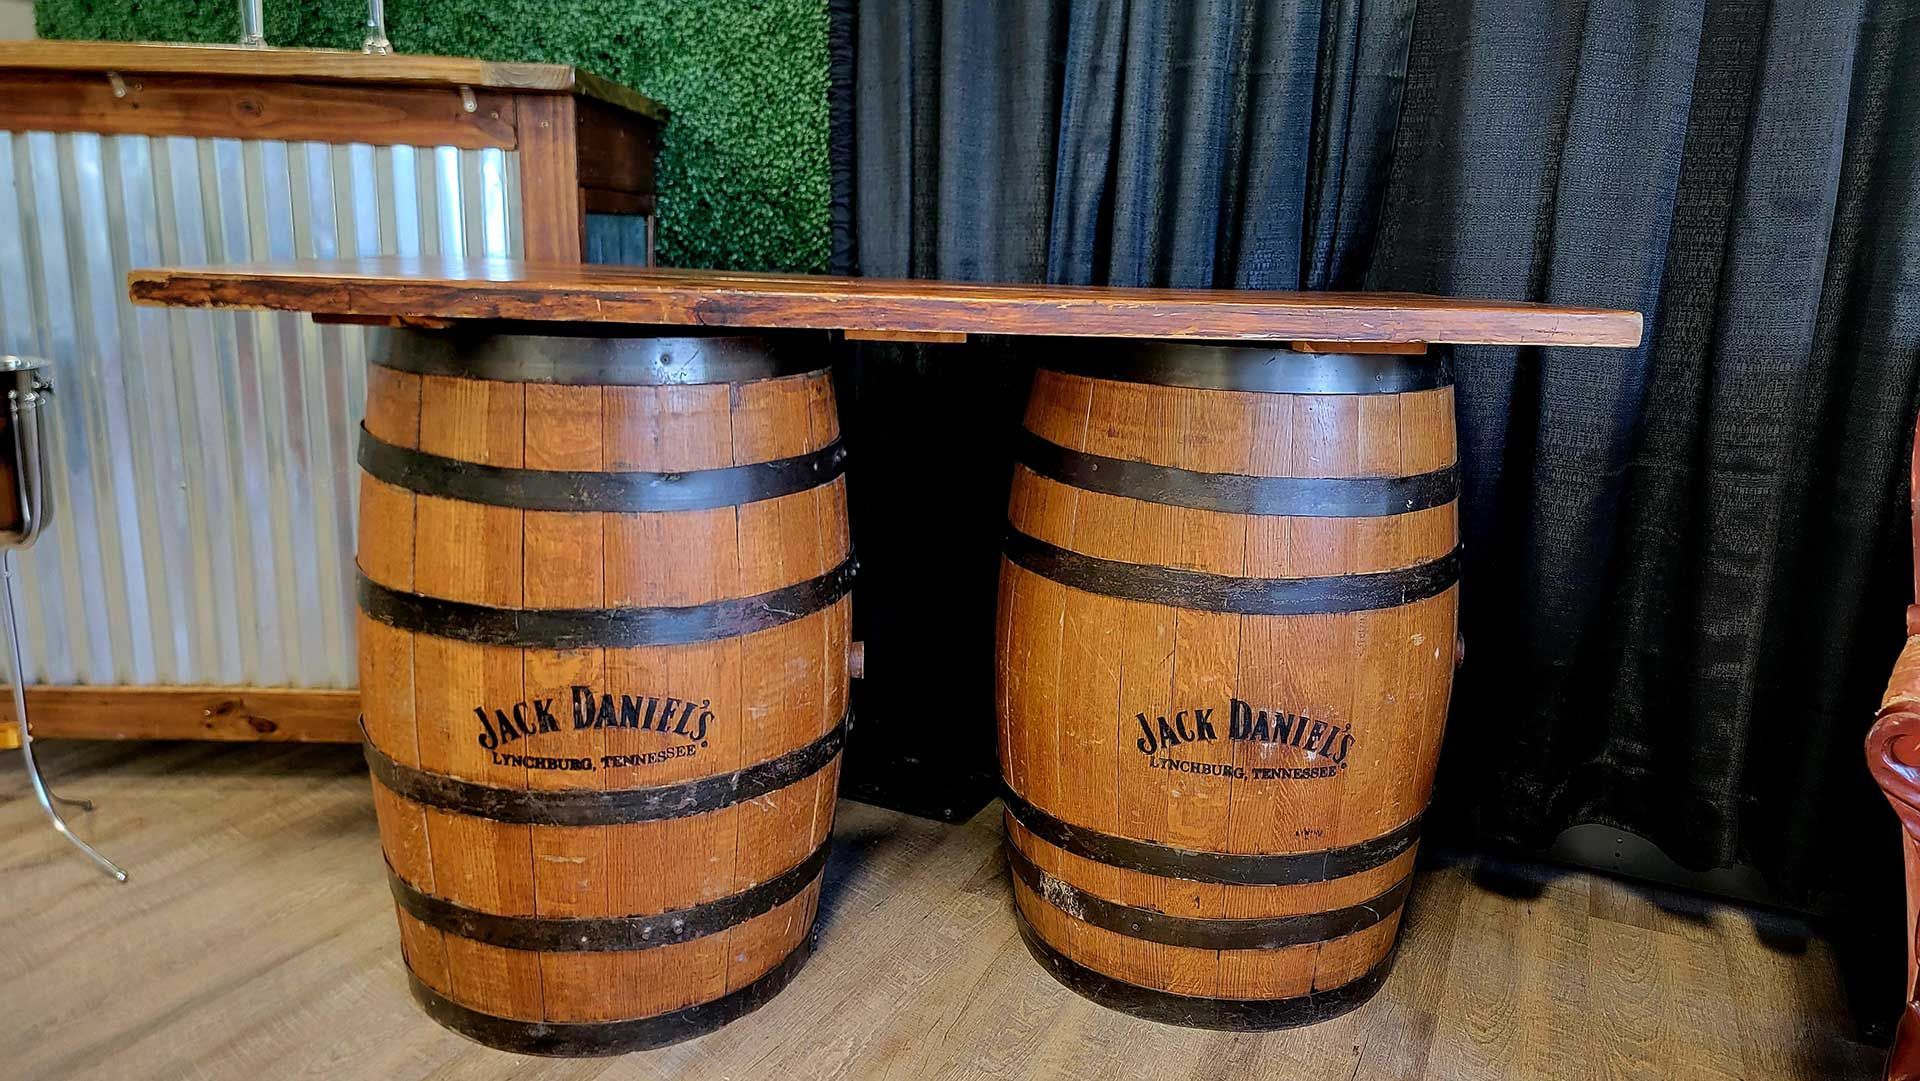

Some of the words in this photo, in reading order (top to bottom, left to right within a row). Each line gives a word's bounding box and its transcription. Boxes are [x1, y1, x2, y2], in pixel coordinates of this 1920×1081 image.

[473, 698, 561, 749] JACK
[1135, 707, 1217, 755] JACK
[492, 751, 597, 772] LYNCHBURG,
[601, 744, 697, 768] TENNESSEE
[1149, 755, 1248, 780] LYNCHBURG,
[1252, 765, 1337, 780] TENNESSEE
